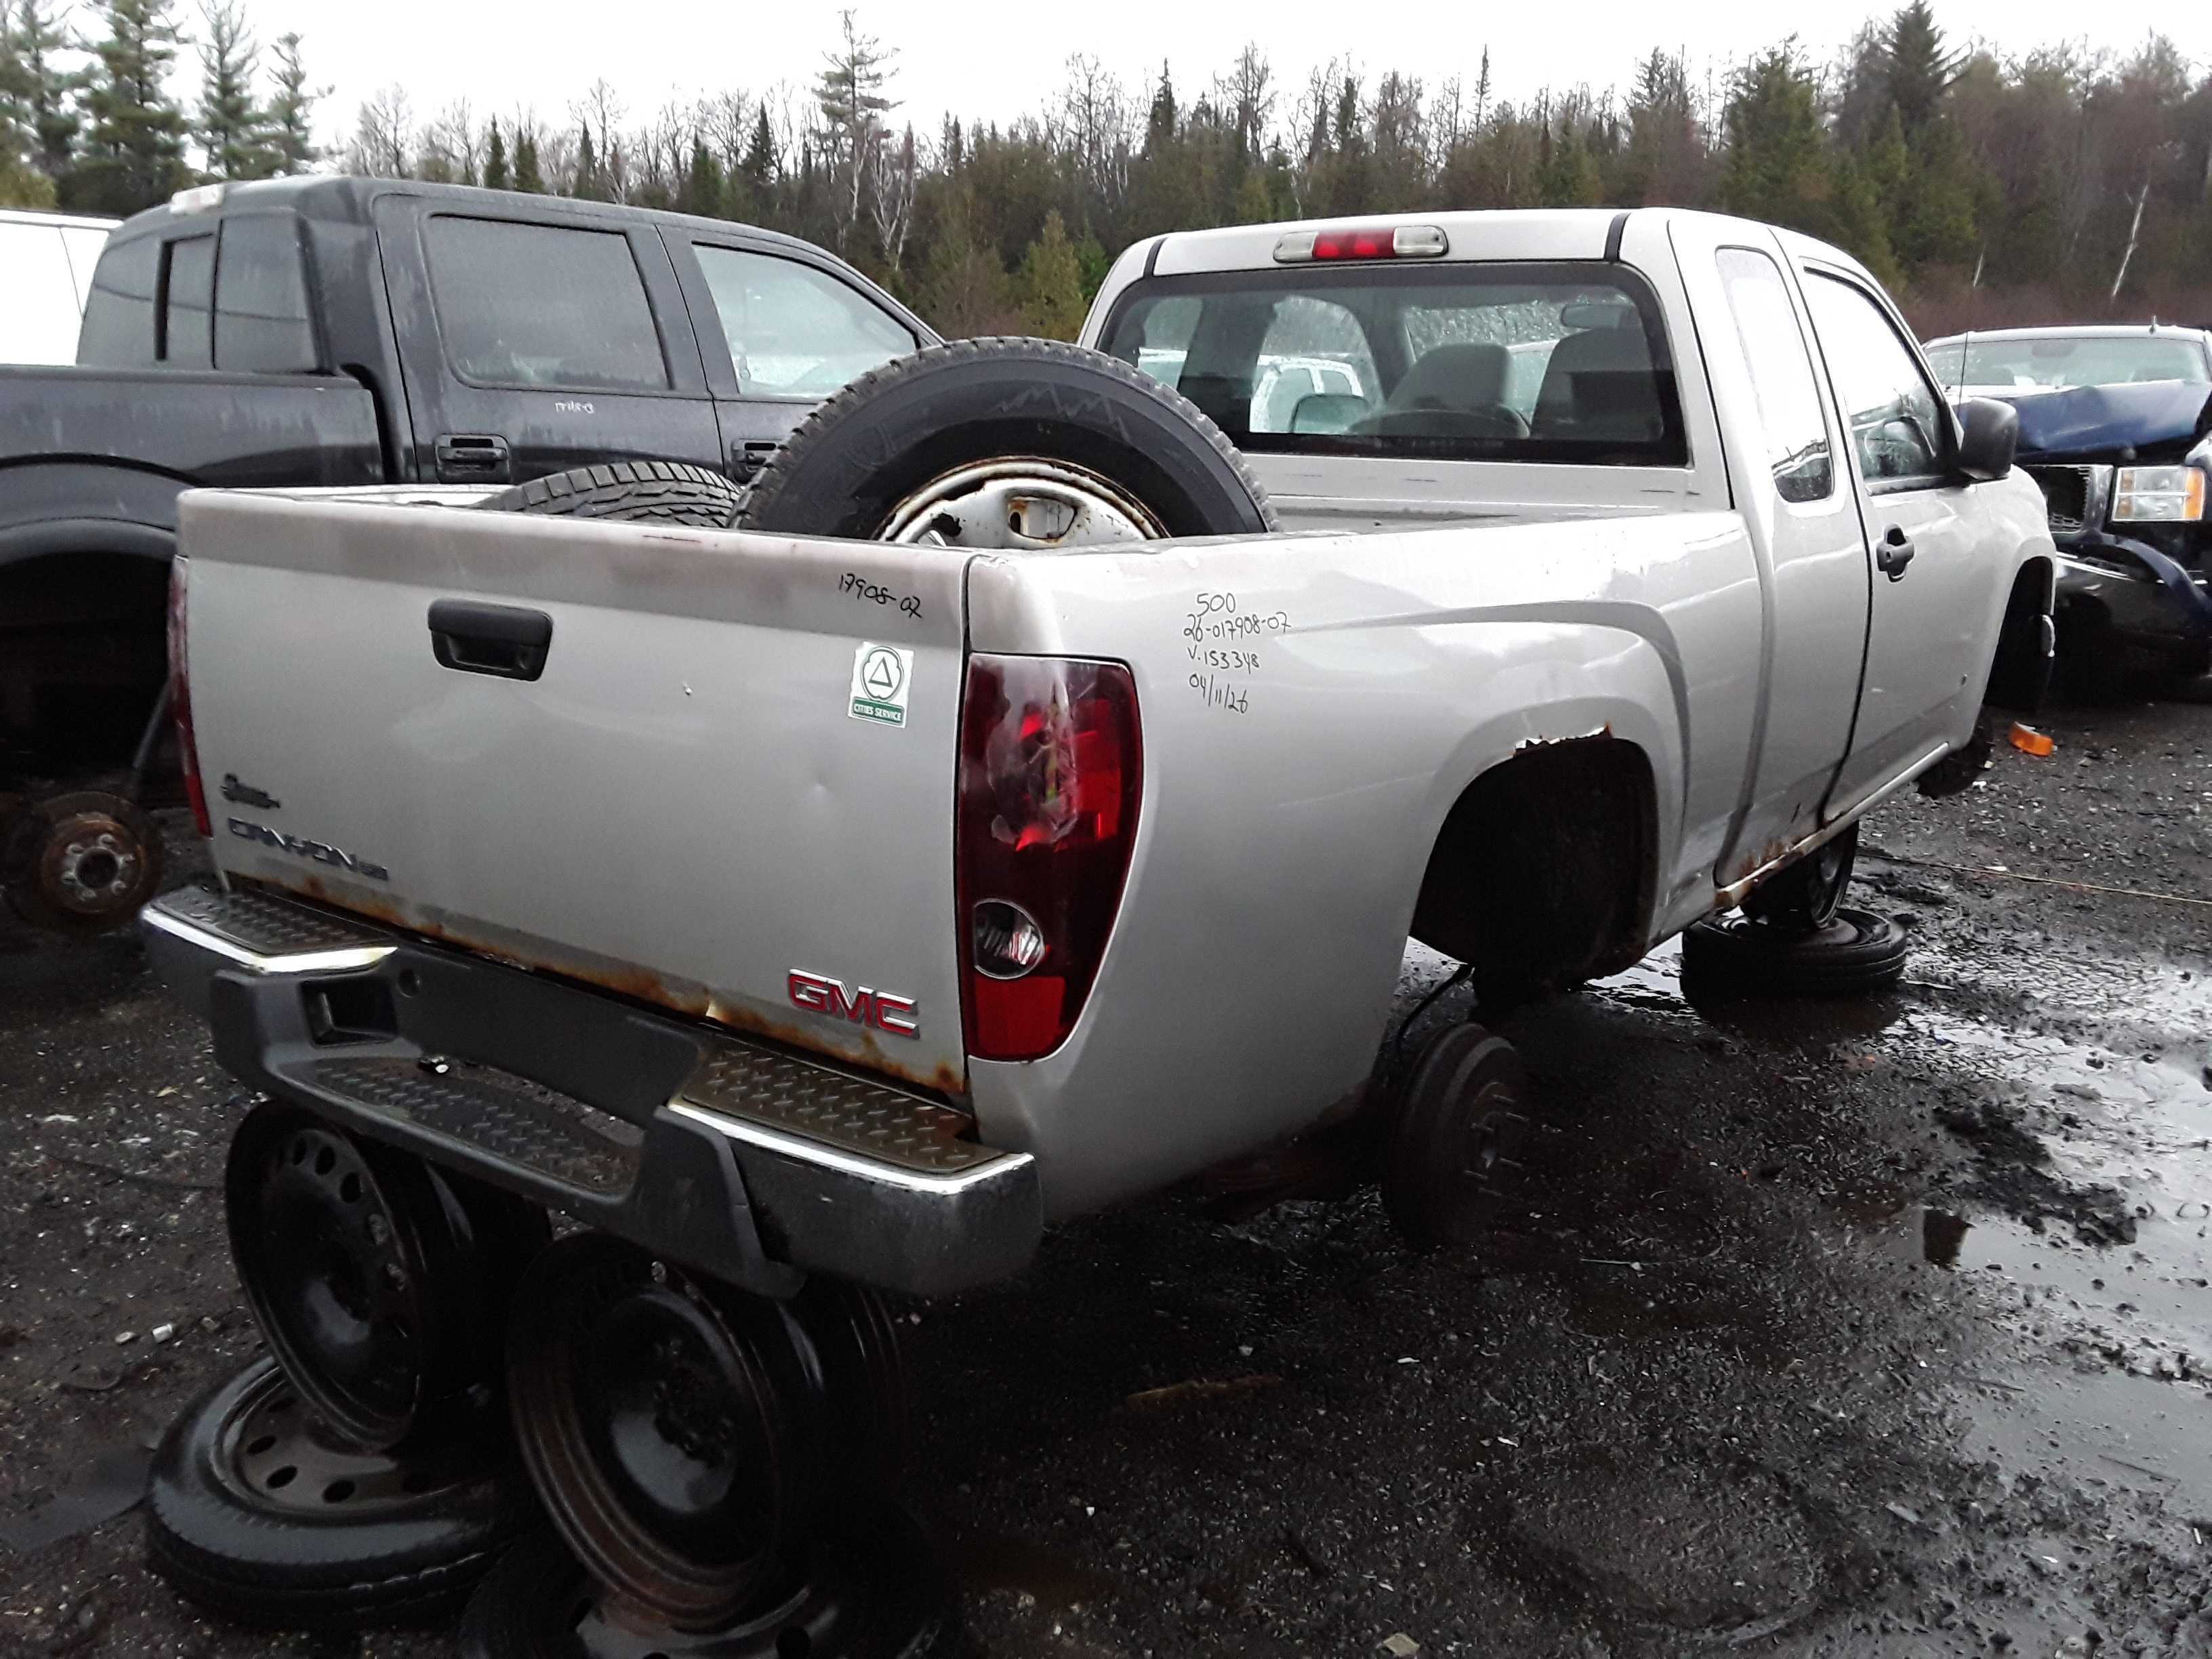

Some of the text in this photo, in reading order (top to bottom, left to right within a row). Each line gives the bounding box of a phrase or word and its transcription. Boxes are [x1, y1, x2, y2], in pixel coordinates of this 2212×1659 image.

[1196, 592, 1236, 617] 500
[1183, 611, 1292, 642] 26-017908-07
[1189, 673, 1248, 714] 04/11/26
[227, 817, 359, 872] CANYON
[788, 966, 921, 1041] GMC
